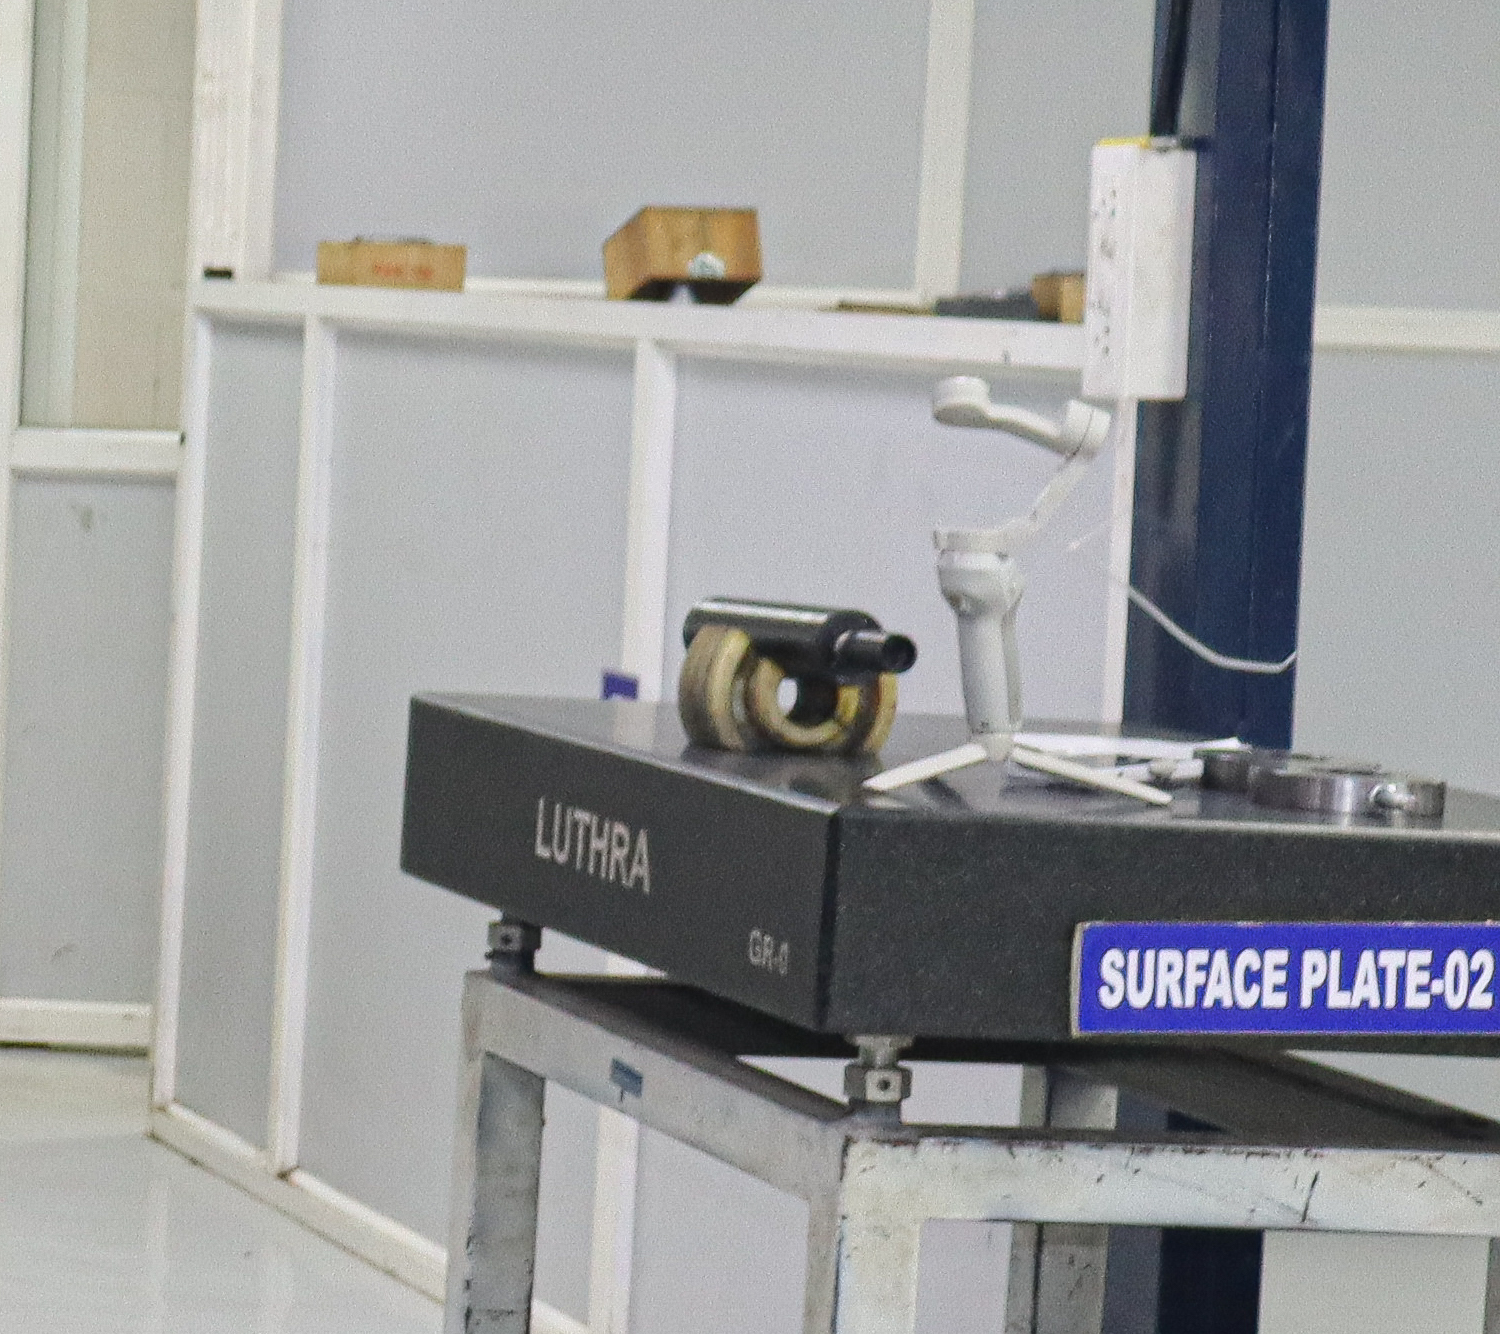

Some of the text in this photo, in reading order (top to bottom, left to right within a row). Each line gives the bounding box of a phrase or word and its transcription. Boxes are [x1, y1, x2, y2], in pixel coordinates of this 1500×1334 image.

[534, 794, 651, 896] LUTHRA
[1098, 947, 1496, 1011] SURFACE PLATE-02
